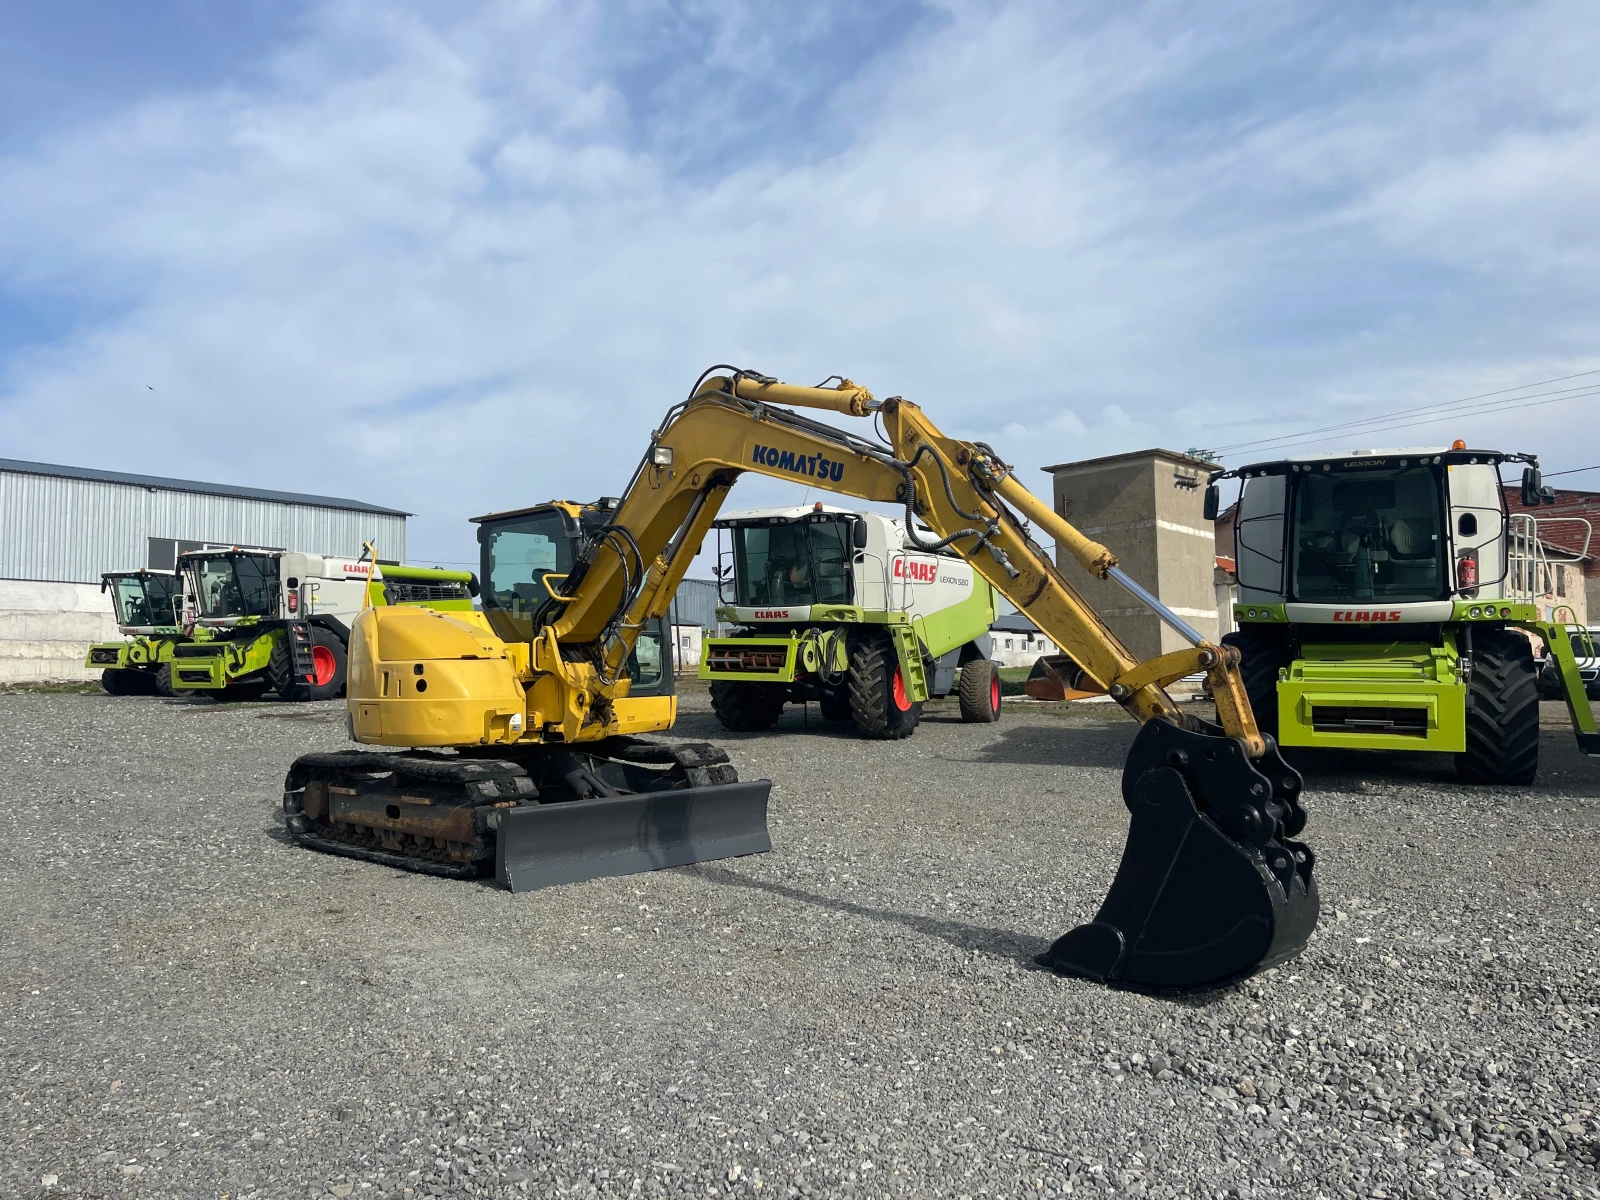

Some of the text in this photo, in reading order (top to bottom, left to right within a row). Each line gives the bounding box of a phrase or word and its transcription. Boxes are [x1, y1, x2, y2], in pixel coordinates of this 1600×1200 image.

[752, 444, 844, 482] KOMATSU
[1344, 460, 1386, 468] LEXION
[894, 559, 937, 582] CLAAS
[940, 575, 958, 585] LEXION
[755, 610, 789, 619] CLAAS
[1333, 611, 1402, 622] CLAAS
